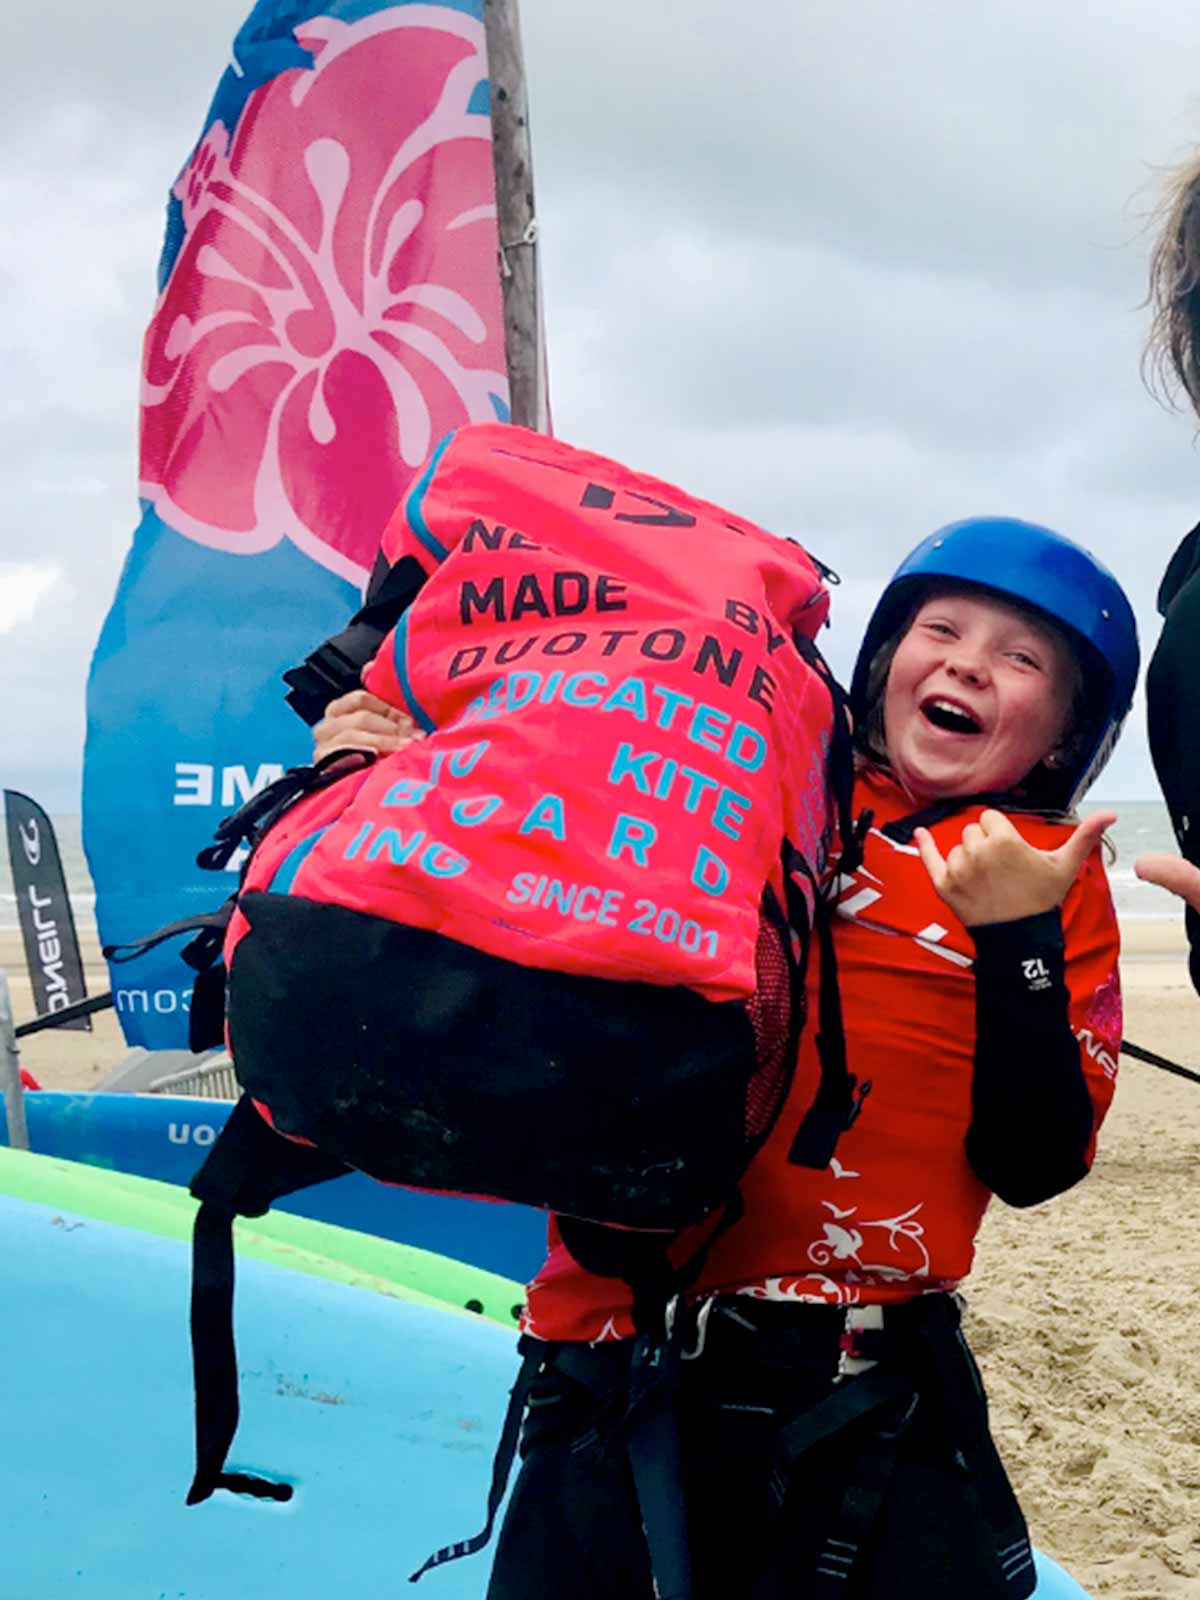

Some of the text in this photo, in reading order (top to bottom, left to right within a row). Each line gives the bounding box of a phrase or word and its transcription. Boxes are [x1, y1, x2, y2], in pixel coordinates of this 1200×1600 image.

[460, 571, 786, 655] MADE BY
[449, 628, 777, 714] DUOTONE
[609, 742, 752, 841] KITE
[343, 822, 470, 878] ING
[380, 778, 730, 896] BOARD
[506, 872, 720, 959] SINCE 2001
